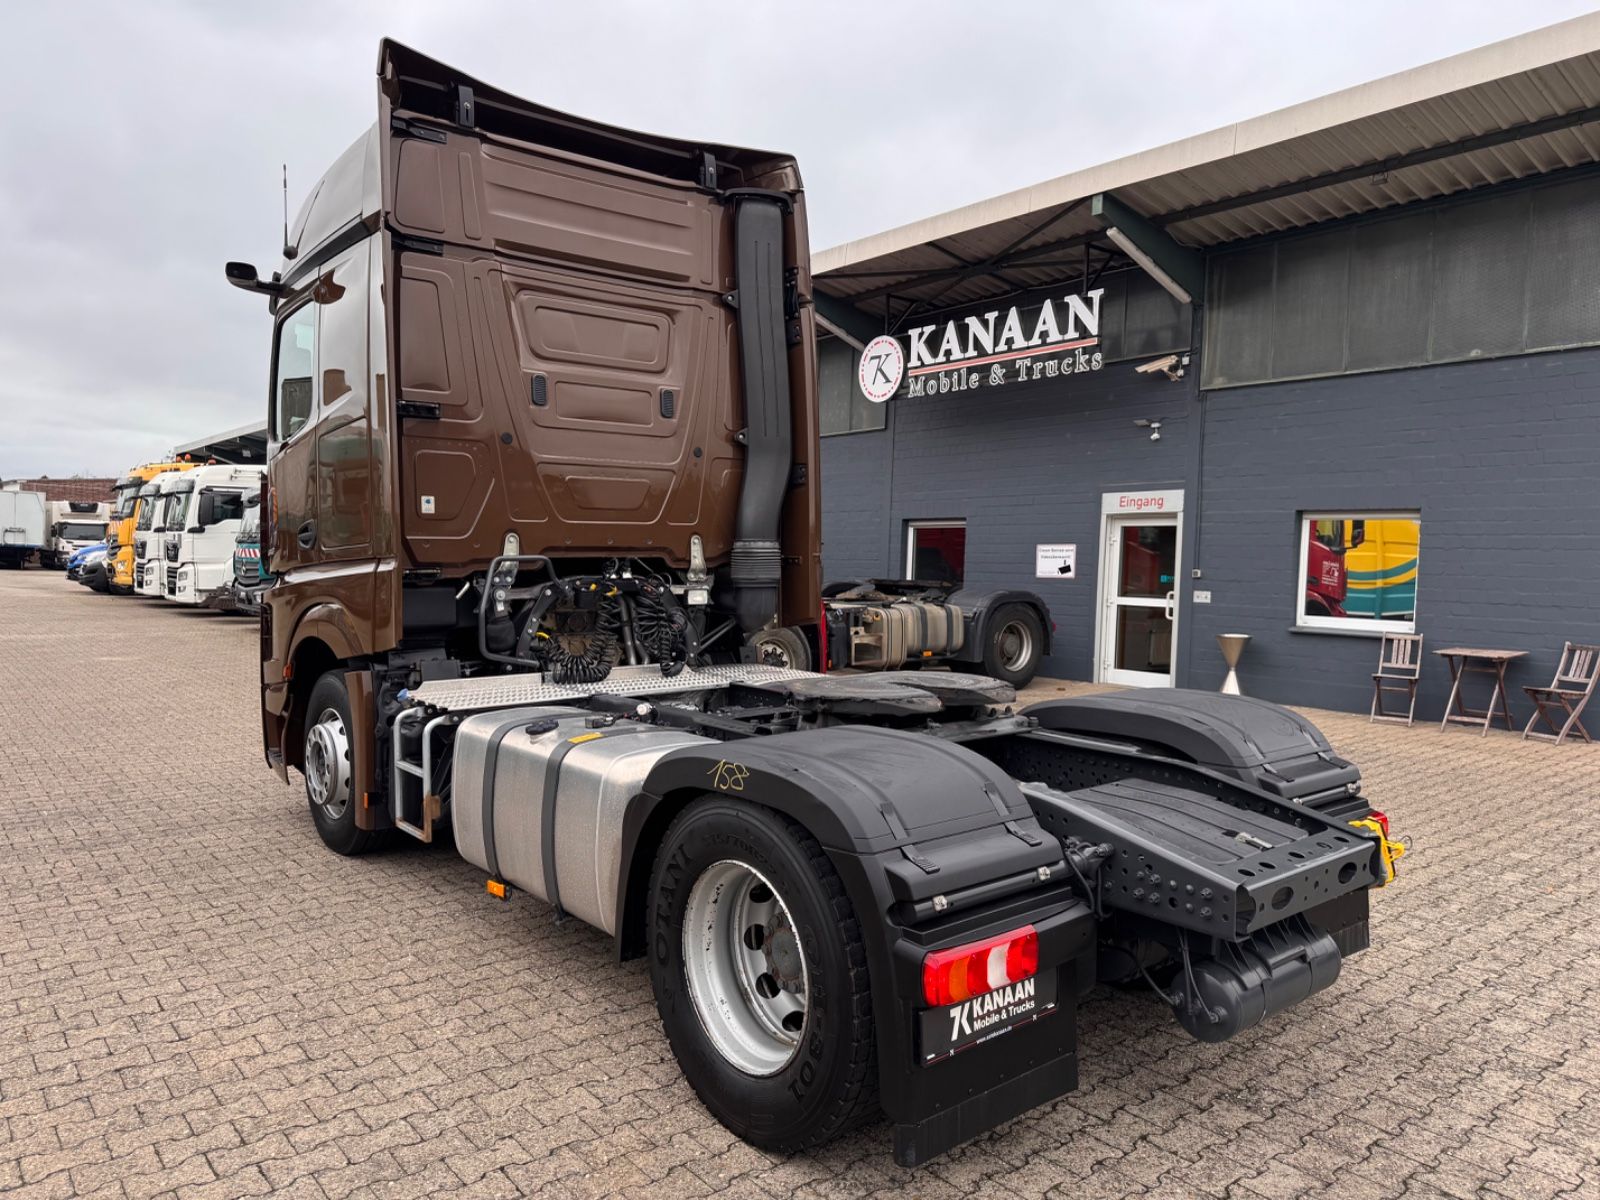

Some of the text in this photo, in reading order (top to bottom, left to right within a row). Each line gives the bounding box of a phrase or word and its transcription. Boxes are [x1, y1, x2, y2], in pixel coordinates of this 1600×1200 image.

[908, 288, 1104, 368] KANAAN
[908, 347, 1102, 398] Mobile & Trucks
[1119, 496, 1164, 510] Eingang
[706, 759, 750, 791] 158
[655, 844, 694, 966] OTANI
[973, 977, 1035, 1018] KANAAN
[973, 999, 1035, 1032] Mobile & Trucks
